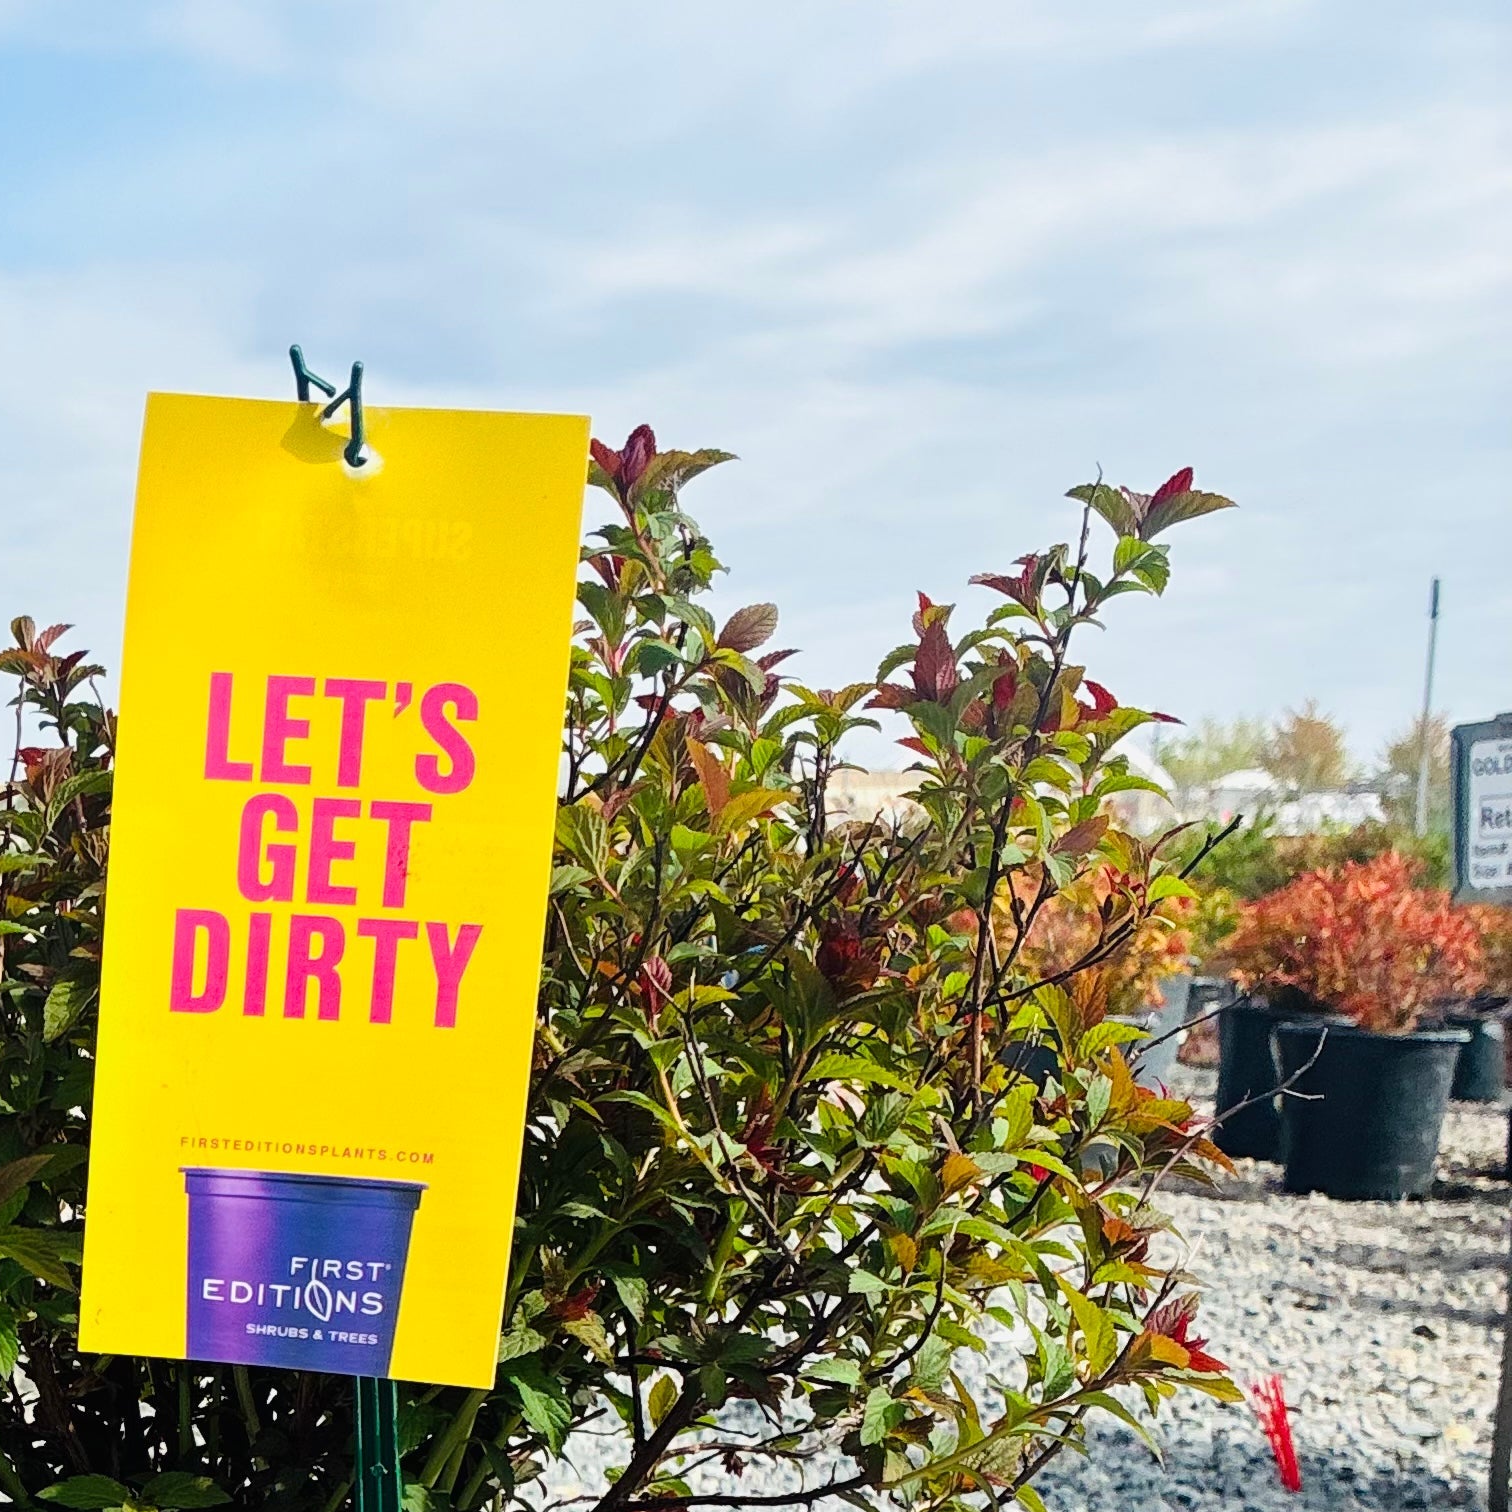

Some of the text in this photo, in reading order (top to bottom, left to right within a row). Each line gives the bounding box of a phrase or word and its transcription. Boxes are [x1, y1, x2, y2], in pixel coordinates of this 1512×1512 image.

[204, 671, 479, 795] LET'S
[236, 792, 433, 909] GET
[169, 907, 484, 1029] DIRTY
[180, 1136, 435, 1164] FIRSTEDITIONSPLANTS.COM
[202, 1278, 384, 1322] EDITIONS
[246, 1323, 378, 1345] SHRUBS & TREES
